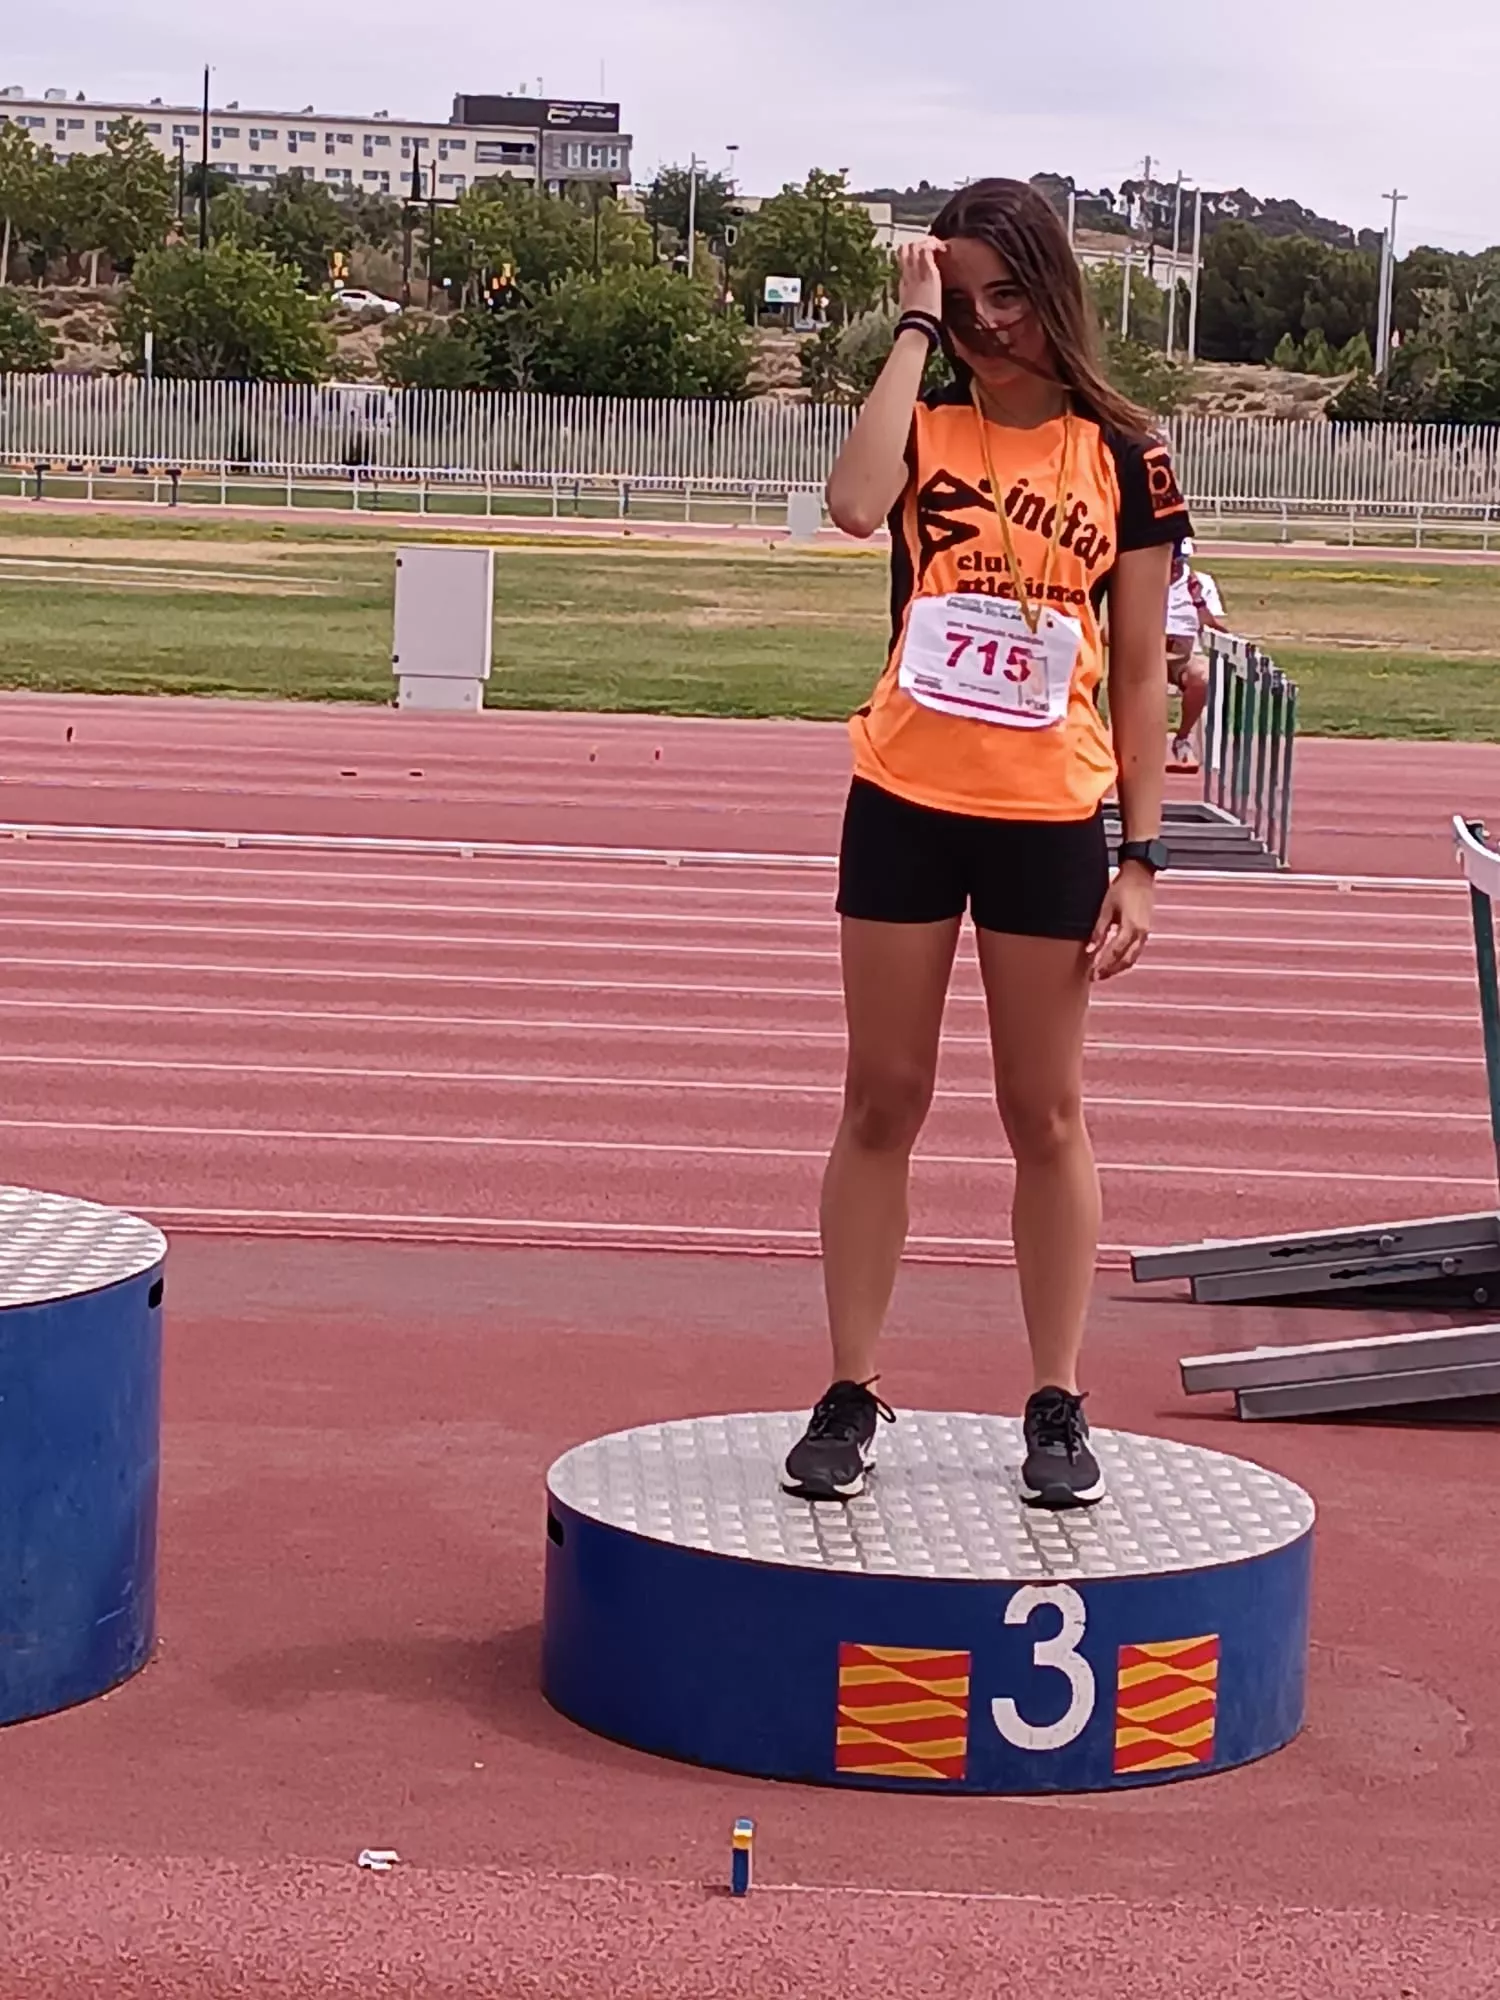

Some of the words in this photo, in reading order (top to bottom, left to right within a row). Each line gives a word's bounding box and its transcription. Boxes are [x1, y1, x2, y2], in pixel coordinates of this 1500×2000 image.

[956, 576, 1086, 606] atleismo
[946, 632, 1032, 683] 715
[991, 1582, 1096, 1751] 3
